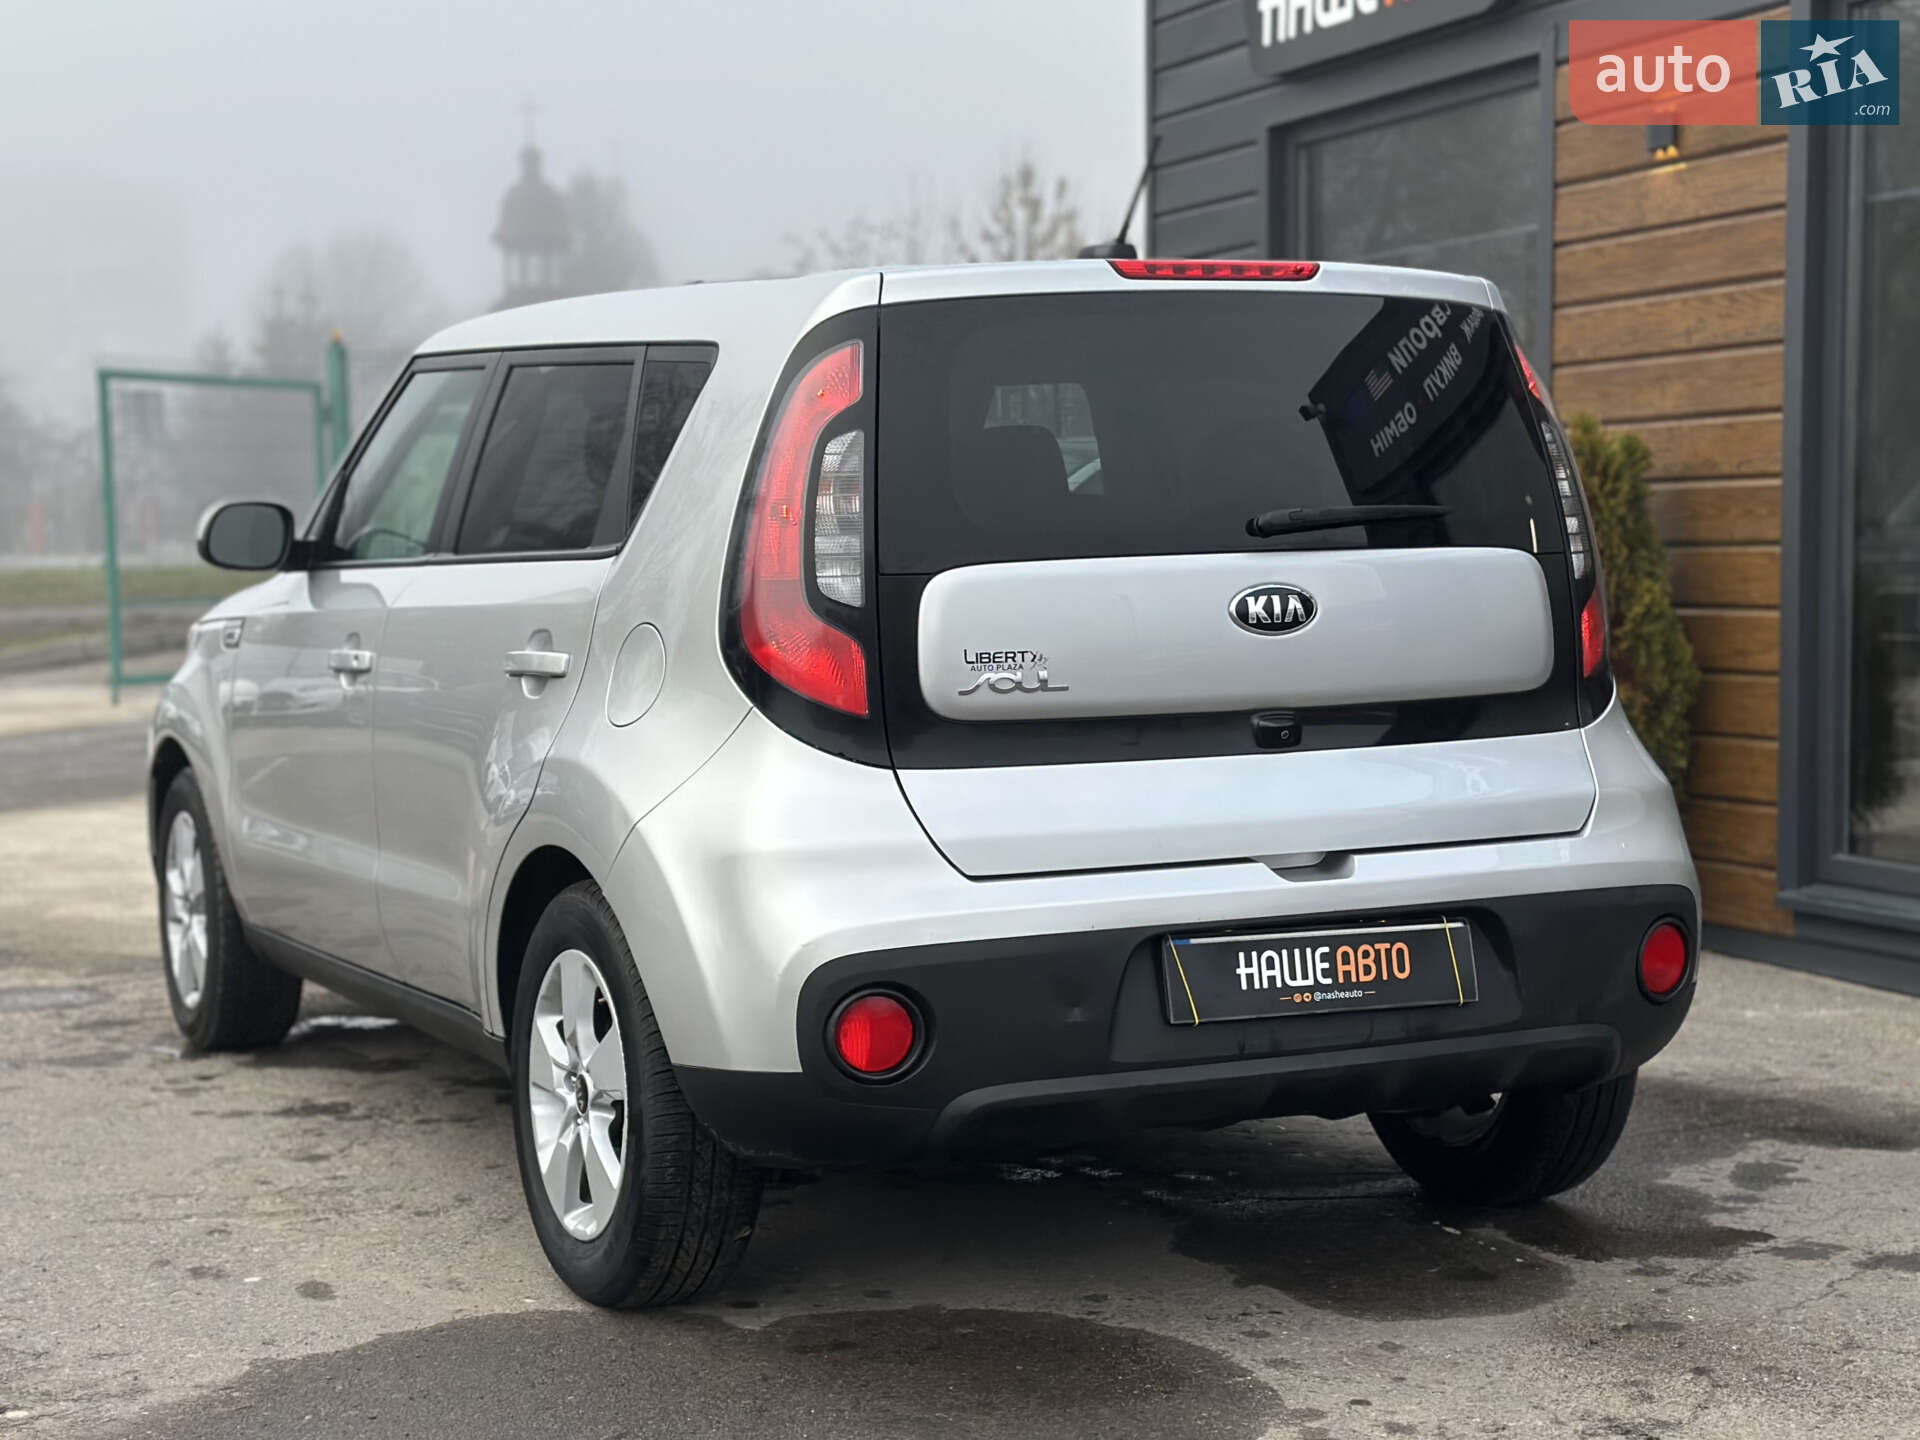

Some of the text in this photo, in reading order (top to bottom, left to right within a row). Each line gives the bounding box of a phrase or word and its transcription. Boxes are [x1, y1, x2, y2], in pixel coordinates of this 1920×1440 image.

[1245, 594, 1307, 624] KIA
[963, 648, 1038, 665] LIBERTY
[970, 663, 1024, 672] AUTO PLAZA
[958, 670, 1069, 696] SOUL
[1313, 989, 1363, 1001] @nasheauto
